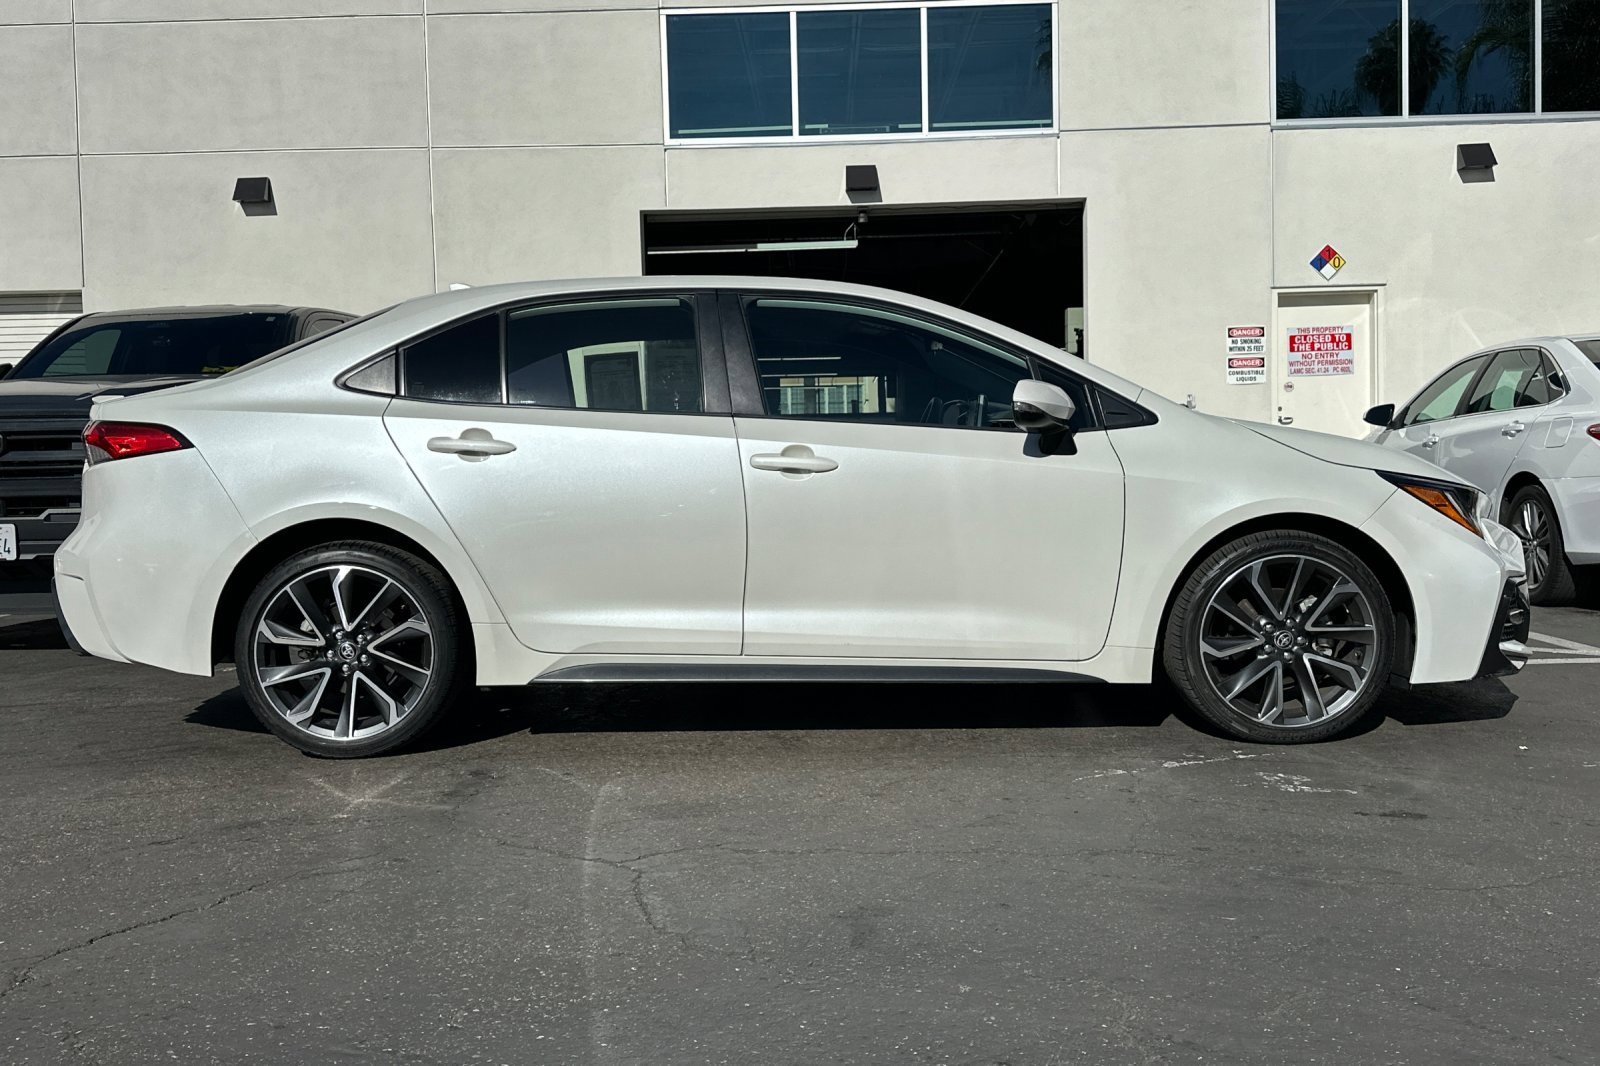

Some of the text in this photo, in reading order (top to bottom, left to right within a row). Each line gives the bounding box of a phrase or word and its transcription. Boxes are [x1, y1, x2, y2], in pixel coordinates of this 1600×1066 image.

[1333, 256, 1340, 268] 0
[1294, 334, 1346, 344] CLOSED TO
[1293, 342, 1348, 352] THE PUBLIC
